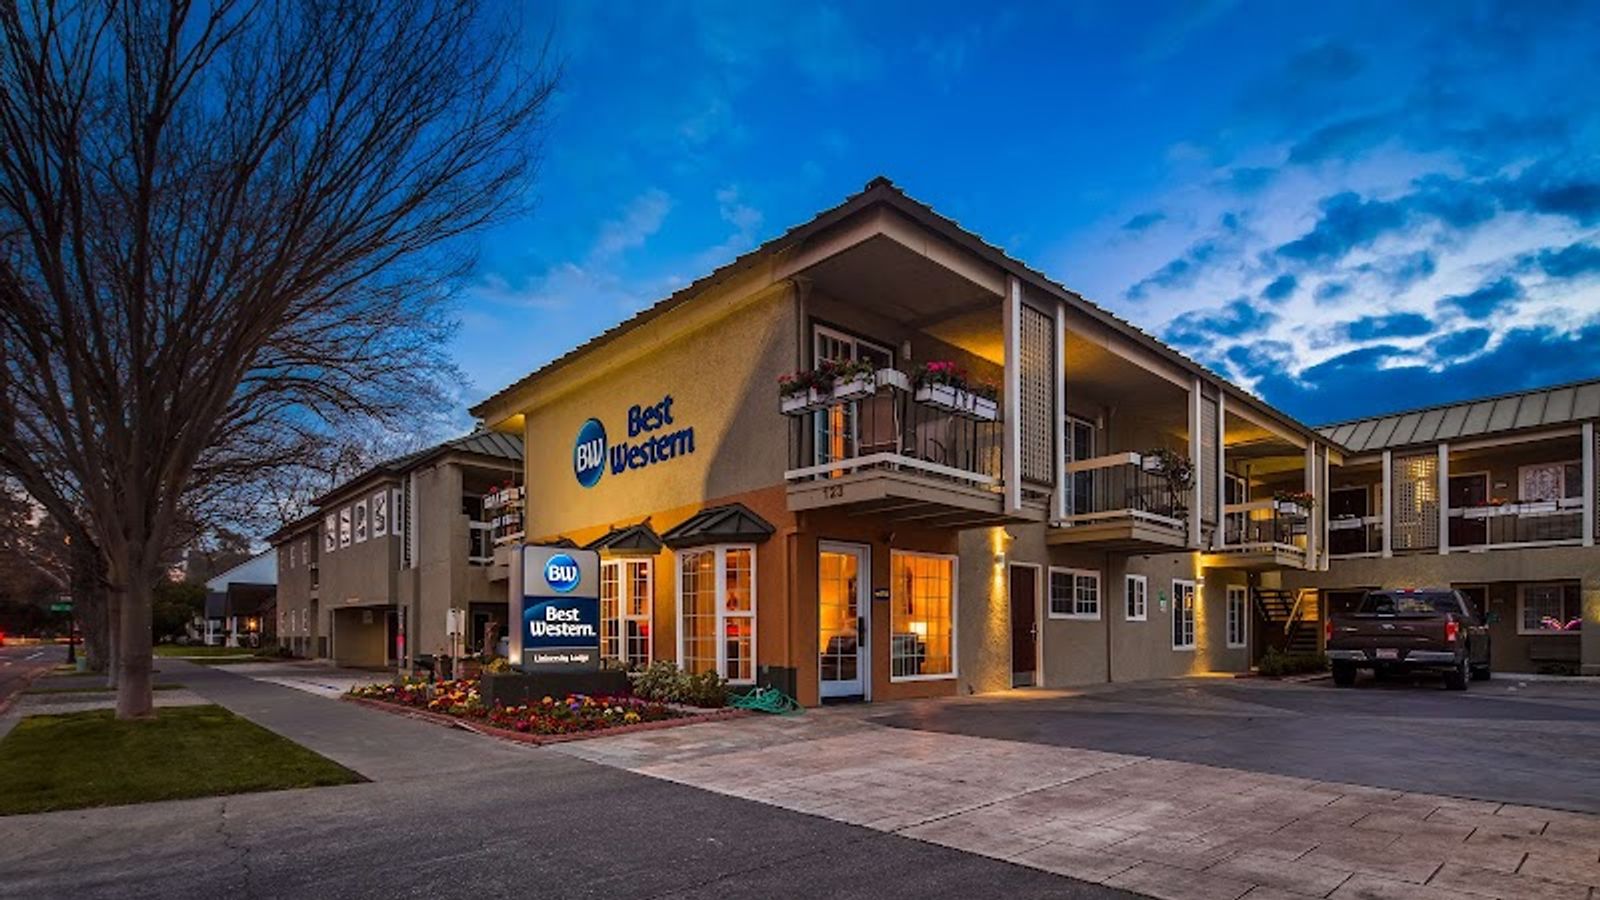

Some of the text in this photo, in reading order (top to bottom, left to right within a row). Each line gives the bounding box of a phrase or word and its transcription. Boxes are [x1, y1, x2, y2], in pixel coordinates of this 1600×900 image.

[627, 394, 674, 438] Best
[576, 438, 603, 473] BW
[609, 426, 695, 475] Western
[823, 484, 843, 499] 123
[548, 565, 577, 582] BW
[545, 605, 580, 621] Best
